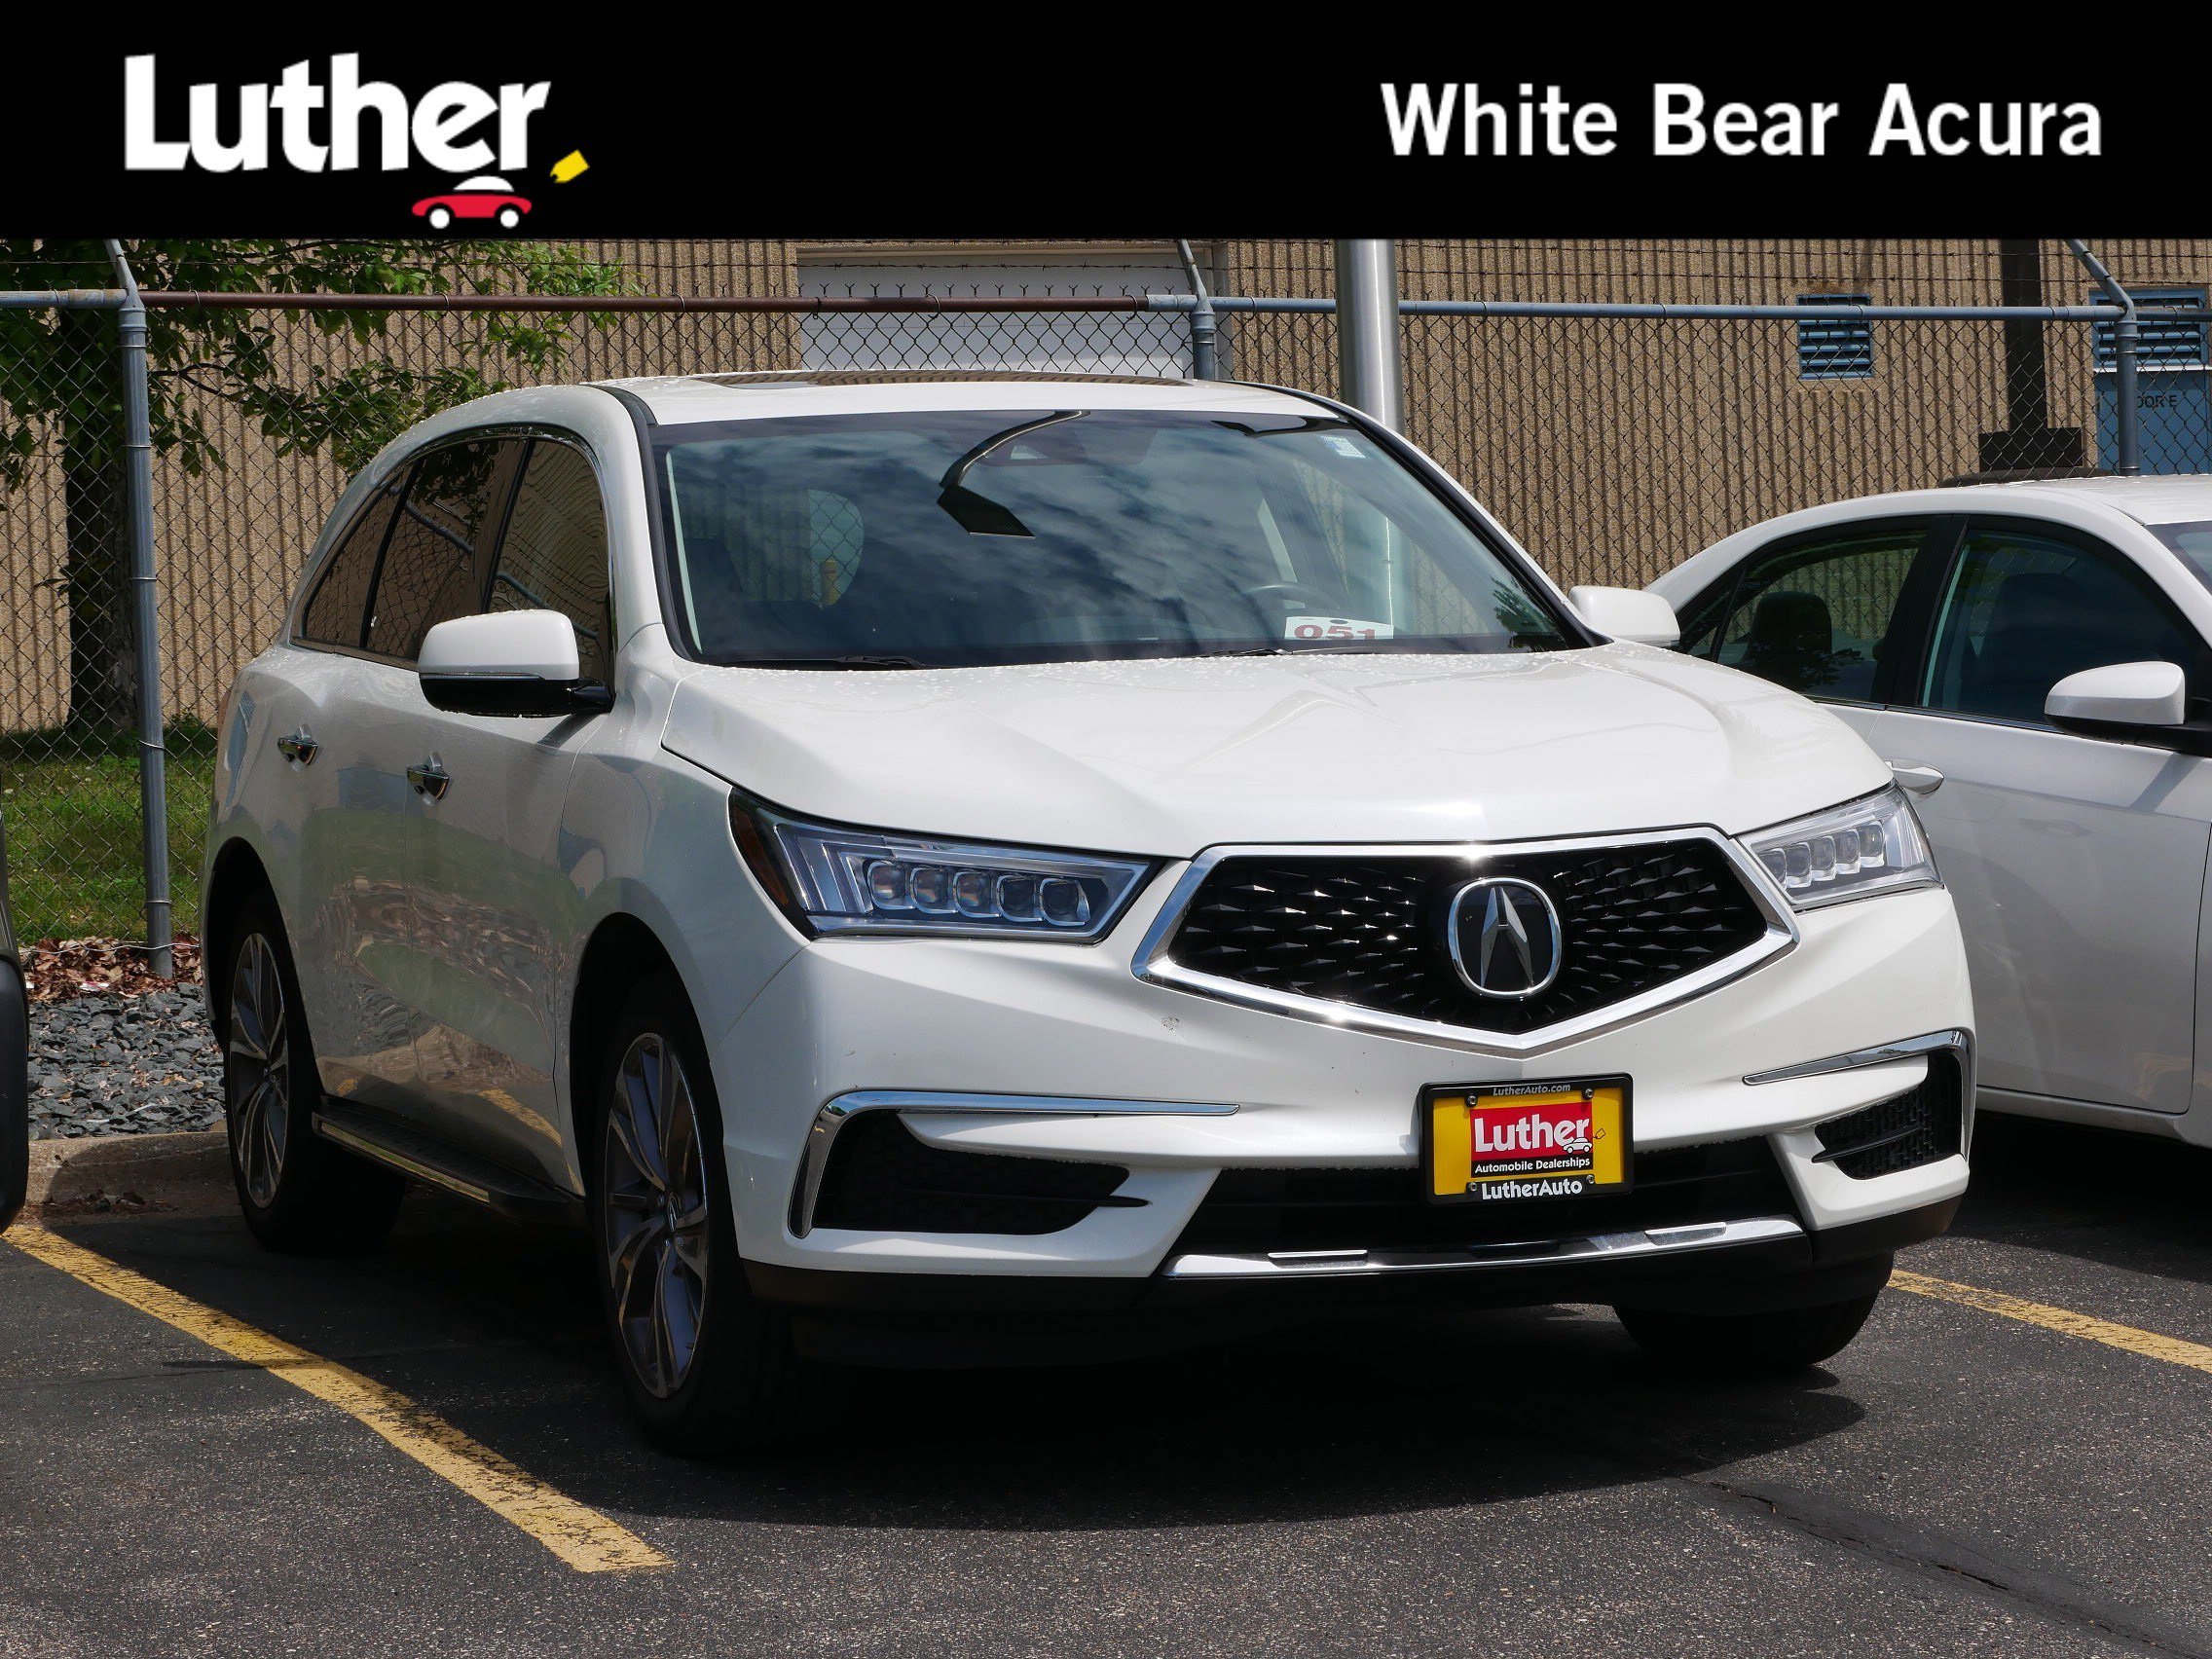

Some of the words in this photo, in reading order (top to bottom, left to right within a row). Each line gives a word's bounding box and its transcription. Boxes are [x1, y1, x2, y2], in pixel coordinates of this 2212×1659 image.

[1293, 624, 1376, 640] 051
[1492, 1083, 1572, 1097] LutherAuto.com
[1473, 1113, 1591, 1153] Luther
[1474, 1161, 1533, 1174] Automobile
[1535, 1157, 1591, 1170] Dealerships
[1481, 1178, 1583, 1200] LutherAuto
